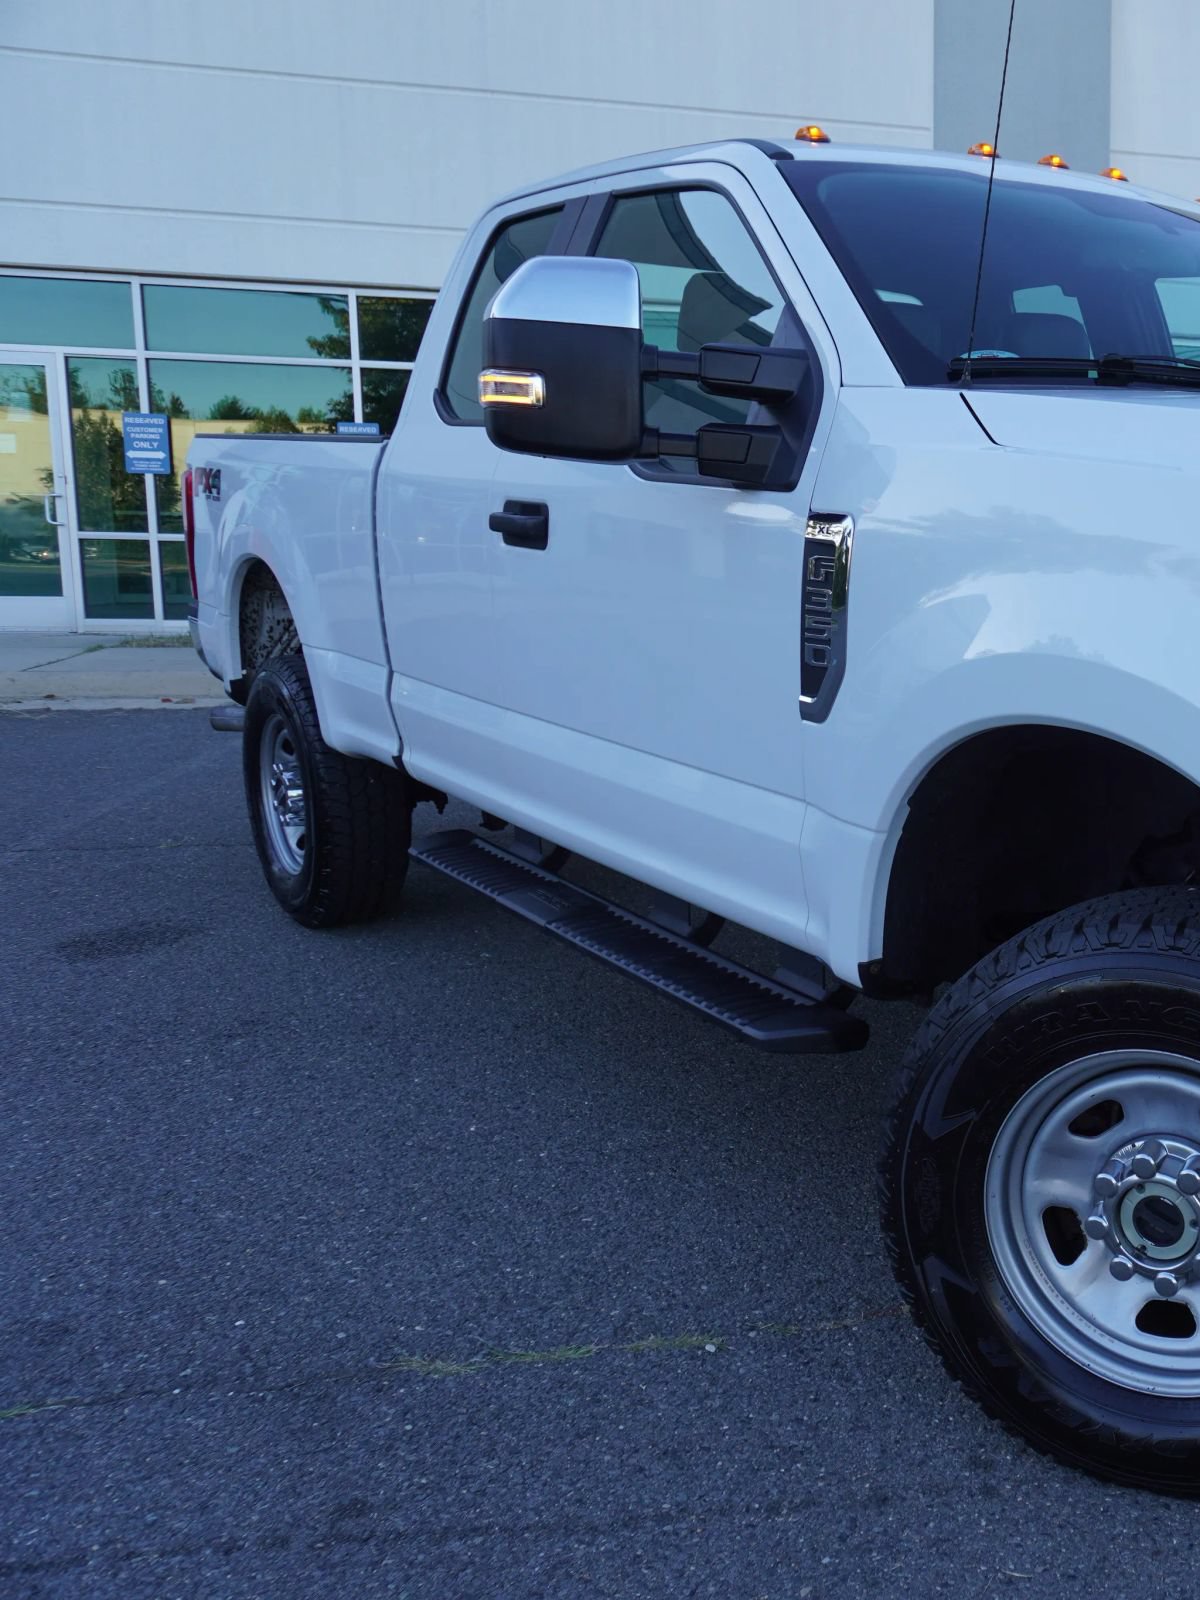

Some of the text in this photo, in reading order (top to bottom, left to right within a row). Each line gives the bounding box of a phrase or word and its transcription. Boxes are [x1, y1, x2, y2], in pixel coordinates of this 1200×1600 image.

[125, 417, 165, 425] RESERVED
[133, 441, 159, 449] ONLY
[195, 467, 221, 497] FX4
[817, 525, 832, 535] XL
